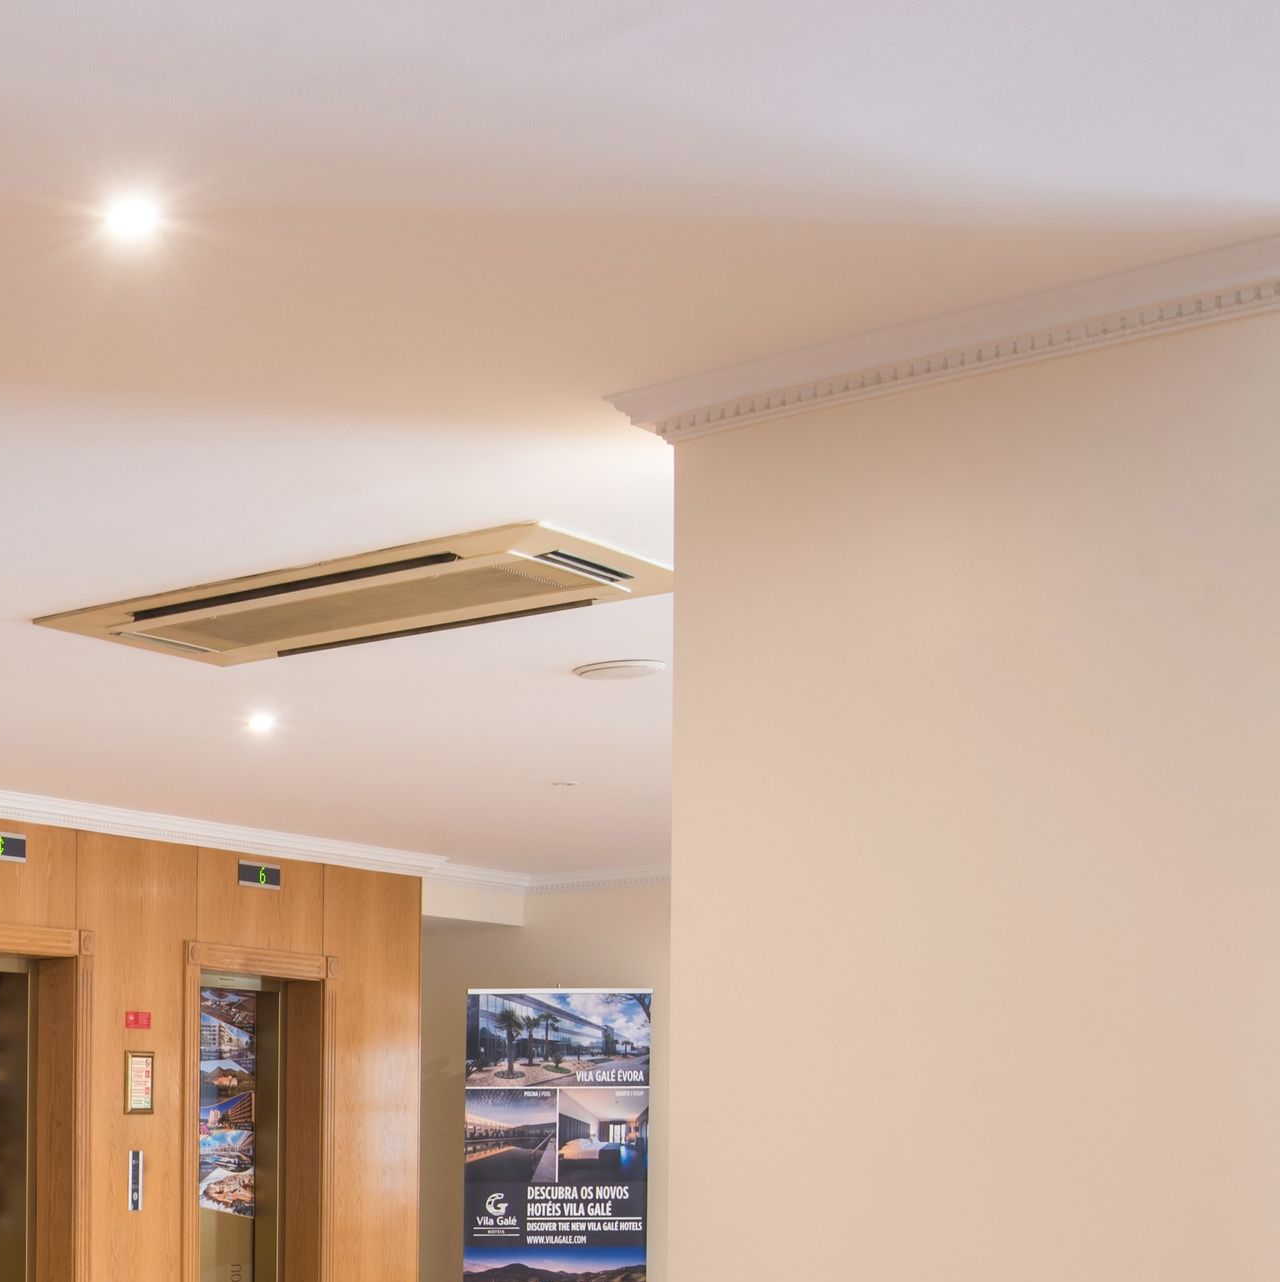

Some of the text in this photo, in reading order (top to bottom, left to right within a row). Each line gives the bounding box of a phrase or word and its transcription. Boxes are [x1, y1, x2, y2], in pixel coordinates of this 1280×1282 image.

[259, 866, 266, 884] 6
[575, 1068, 645, 1082] VILA GALÉ ÉVORA
[527, 1185, 629, 1200] DESCUBRA OS NOVOS
[526, 1200, 612, 1216] HOTÉIS VILA GALÉ
[476, 1216, 517, 1226] Vila Galé
[526, 1220, 642, 1231] DISCOVER THE NEW VILA GALÉ HOTELS
[526, 1235, 587, 1244] WWW.VILAGALE.COM
